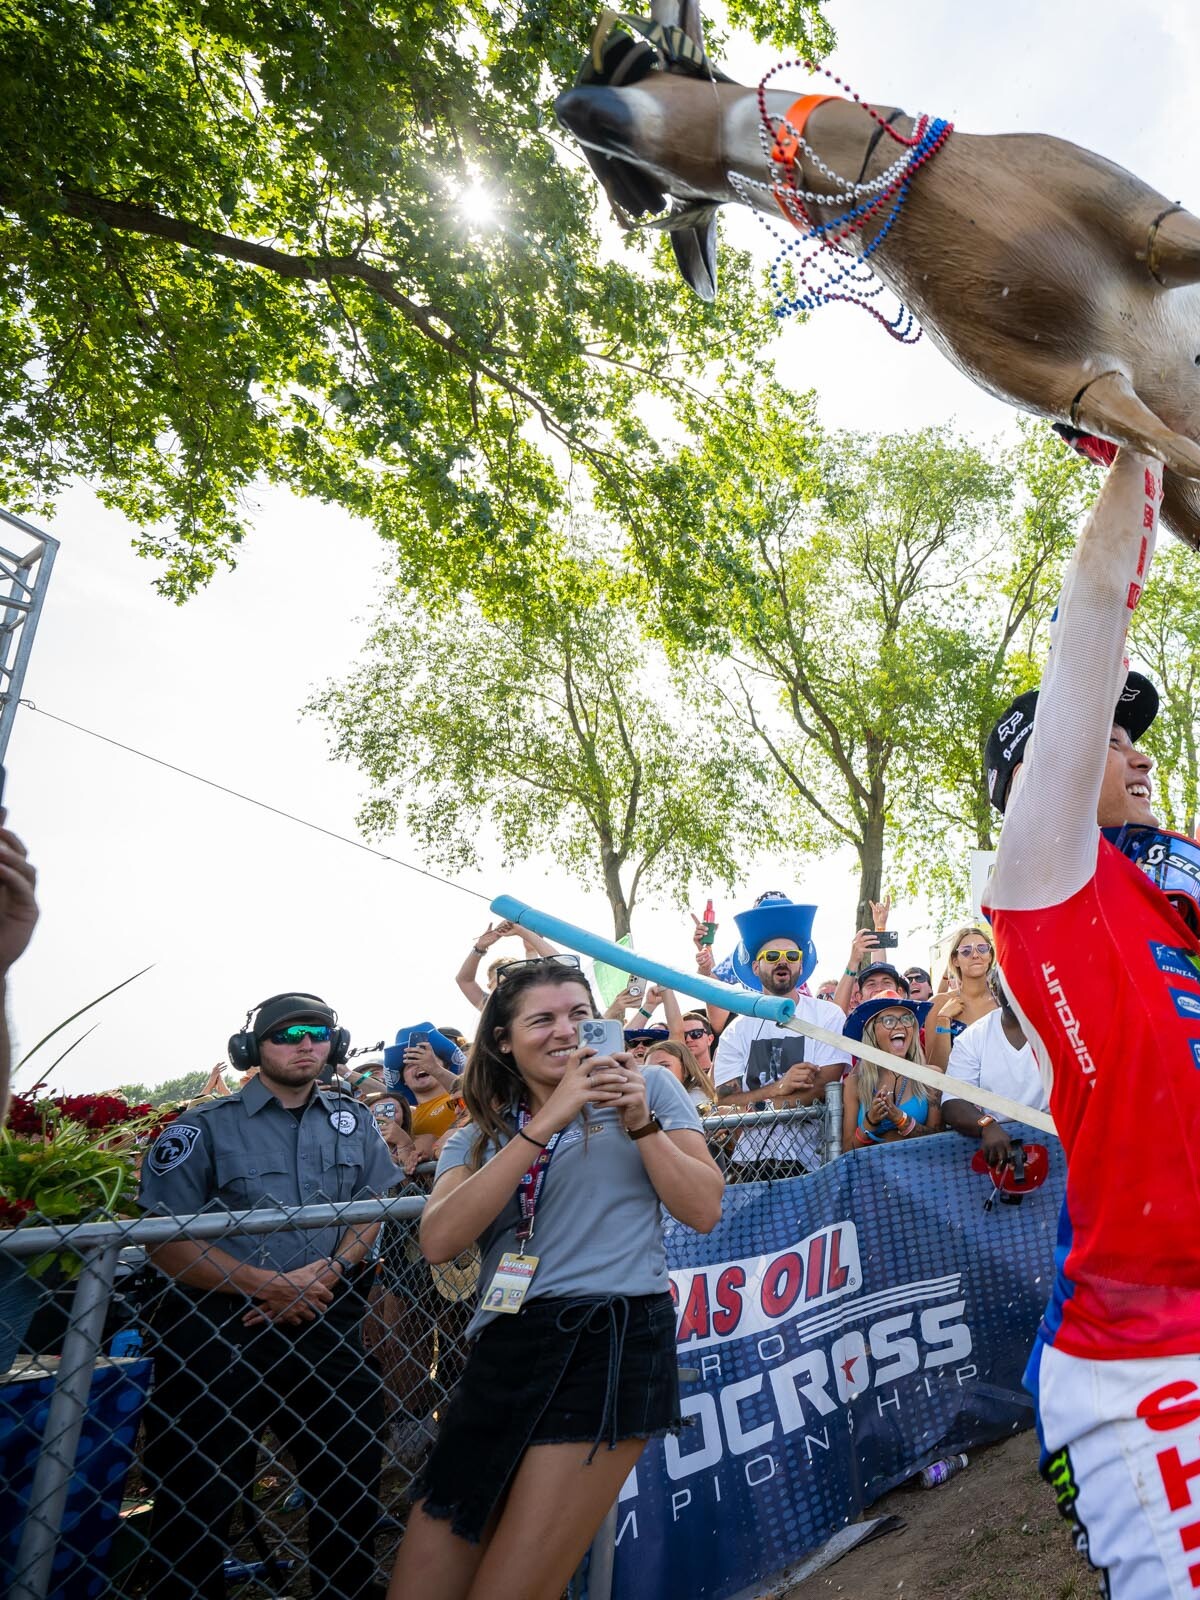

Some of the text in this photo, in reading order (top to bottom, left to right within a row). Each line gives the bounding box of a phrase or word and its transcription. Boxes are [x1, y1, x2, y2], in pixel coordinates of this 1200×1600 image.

[1008, 721, 1034, 753] SCOT
[761, 1227, 850, 1319] OIL
[664, 1299, 973, 1482] OCROSS
